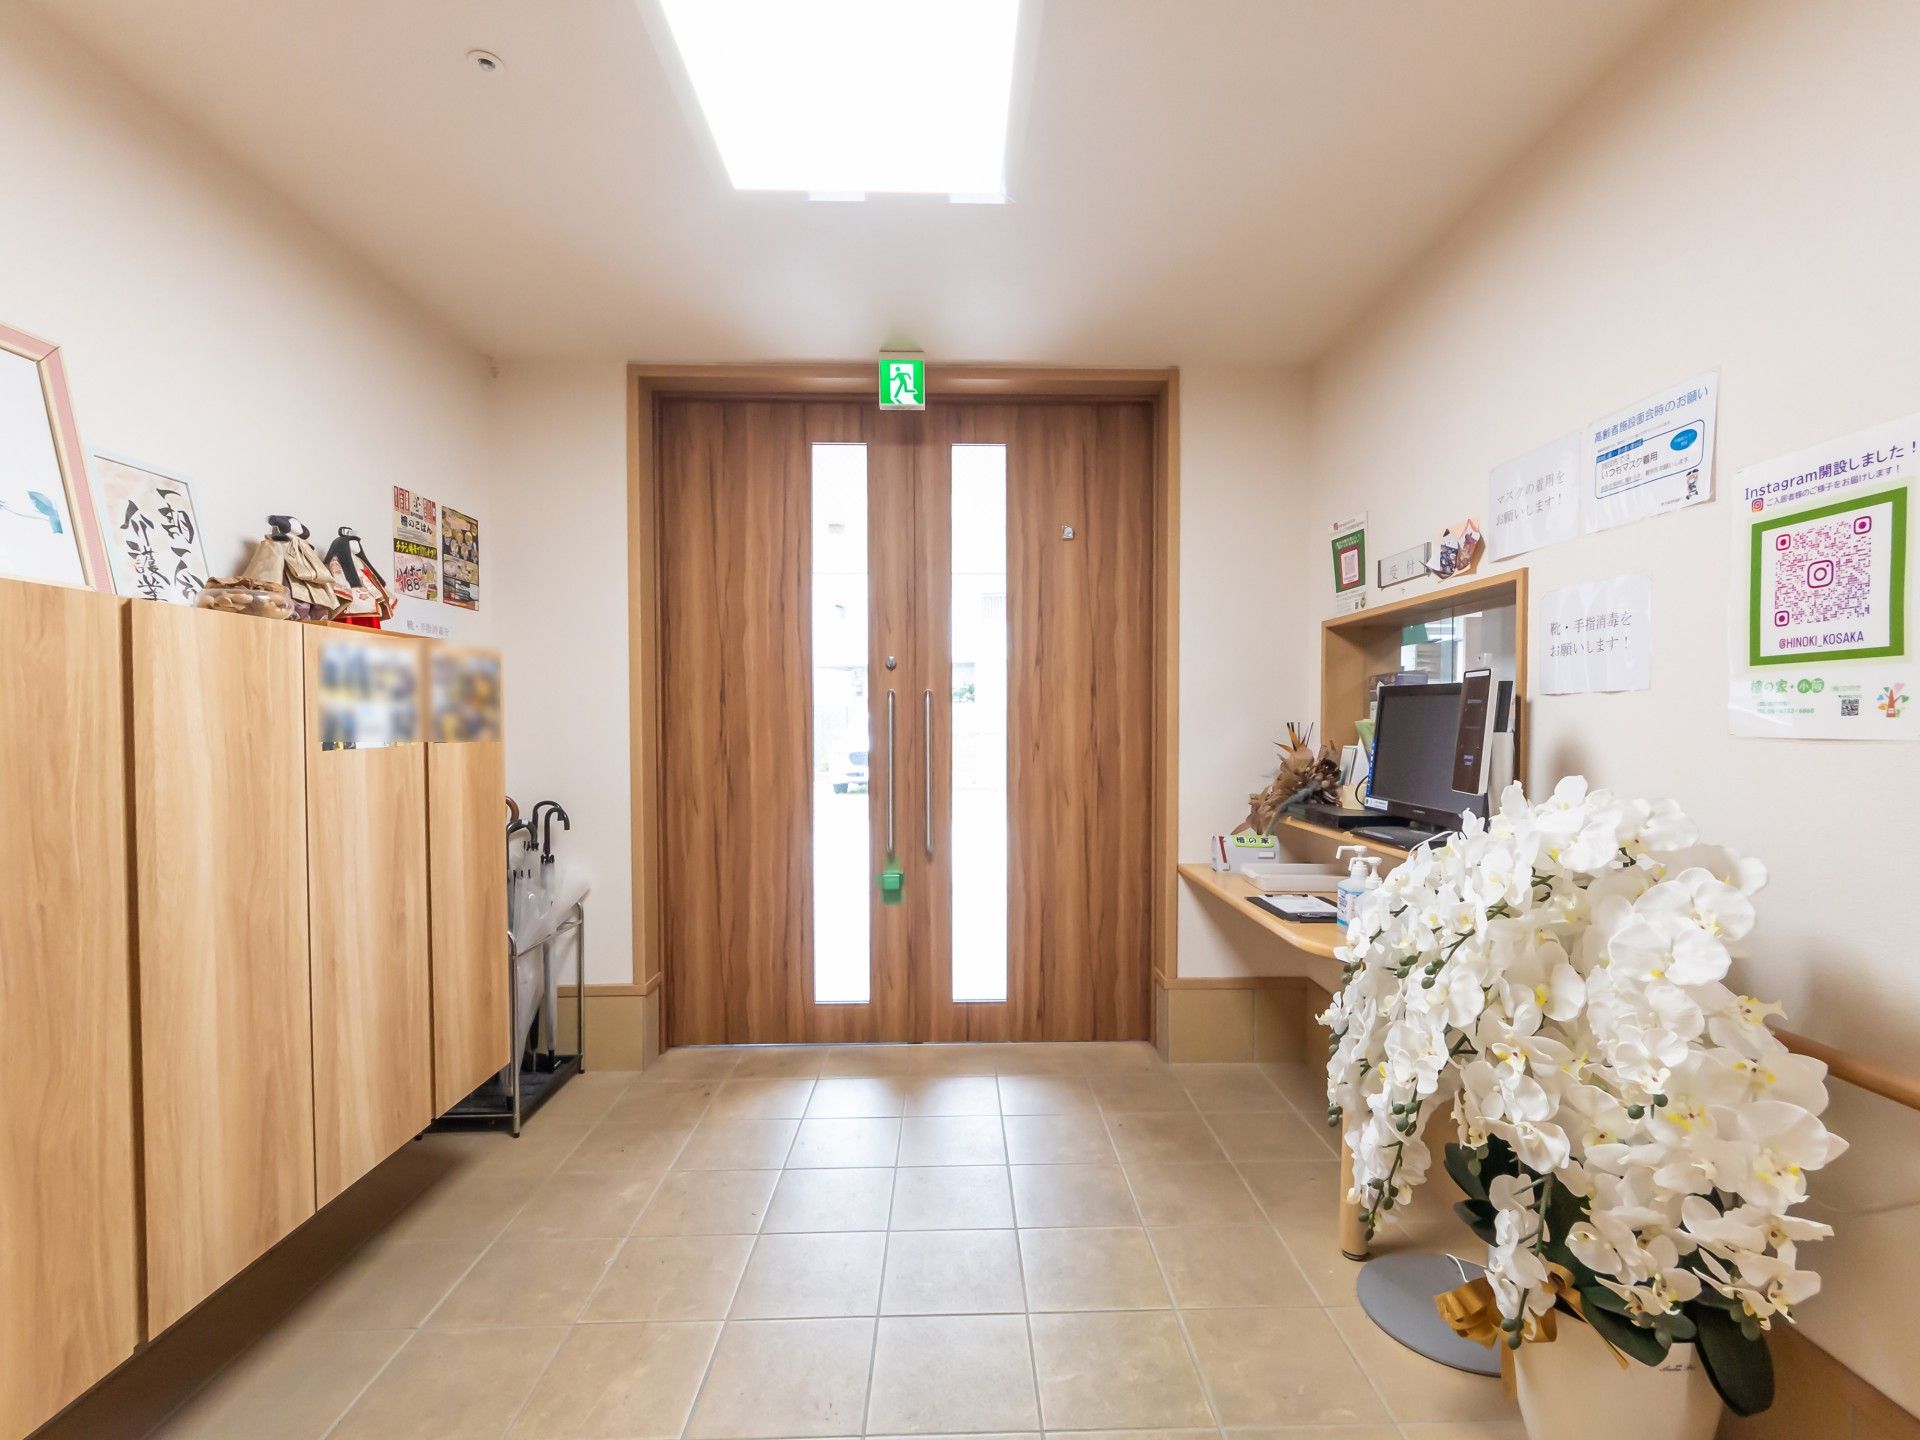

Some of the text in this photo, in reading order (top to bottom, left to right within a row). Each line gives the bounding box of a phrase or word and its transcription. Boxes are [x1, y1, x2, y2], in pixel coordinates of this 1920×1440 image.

[1595, 386, 1708, 442] 高齢者施設面会時のお願い
[1601, 451, 1658, 479] いつもマスク着用
[1497, 470, 1565, 504] マスクの着用を
[1550, 610, 1632, 635] 靴・手指消毒を
[1779, 630, 1865, 649] @HINOKI_KOSAKA
